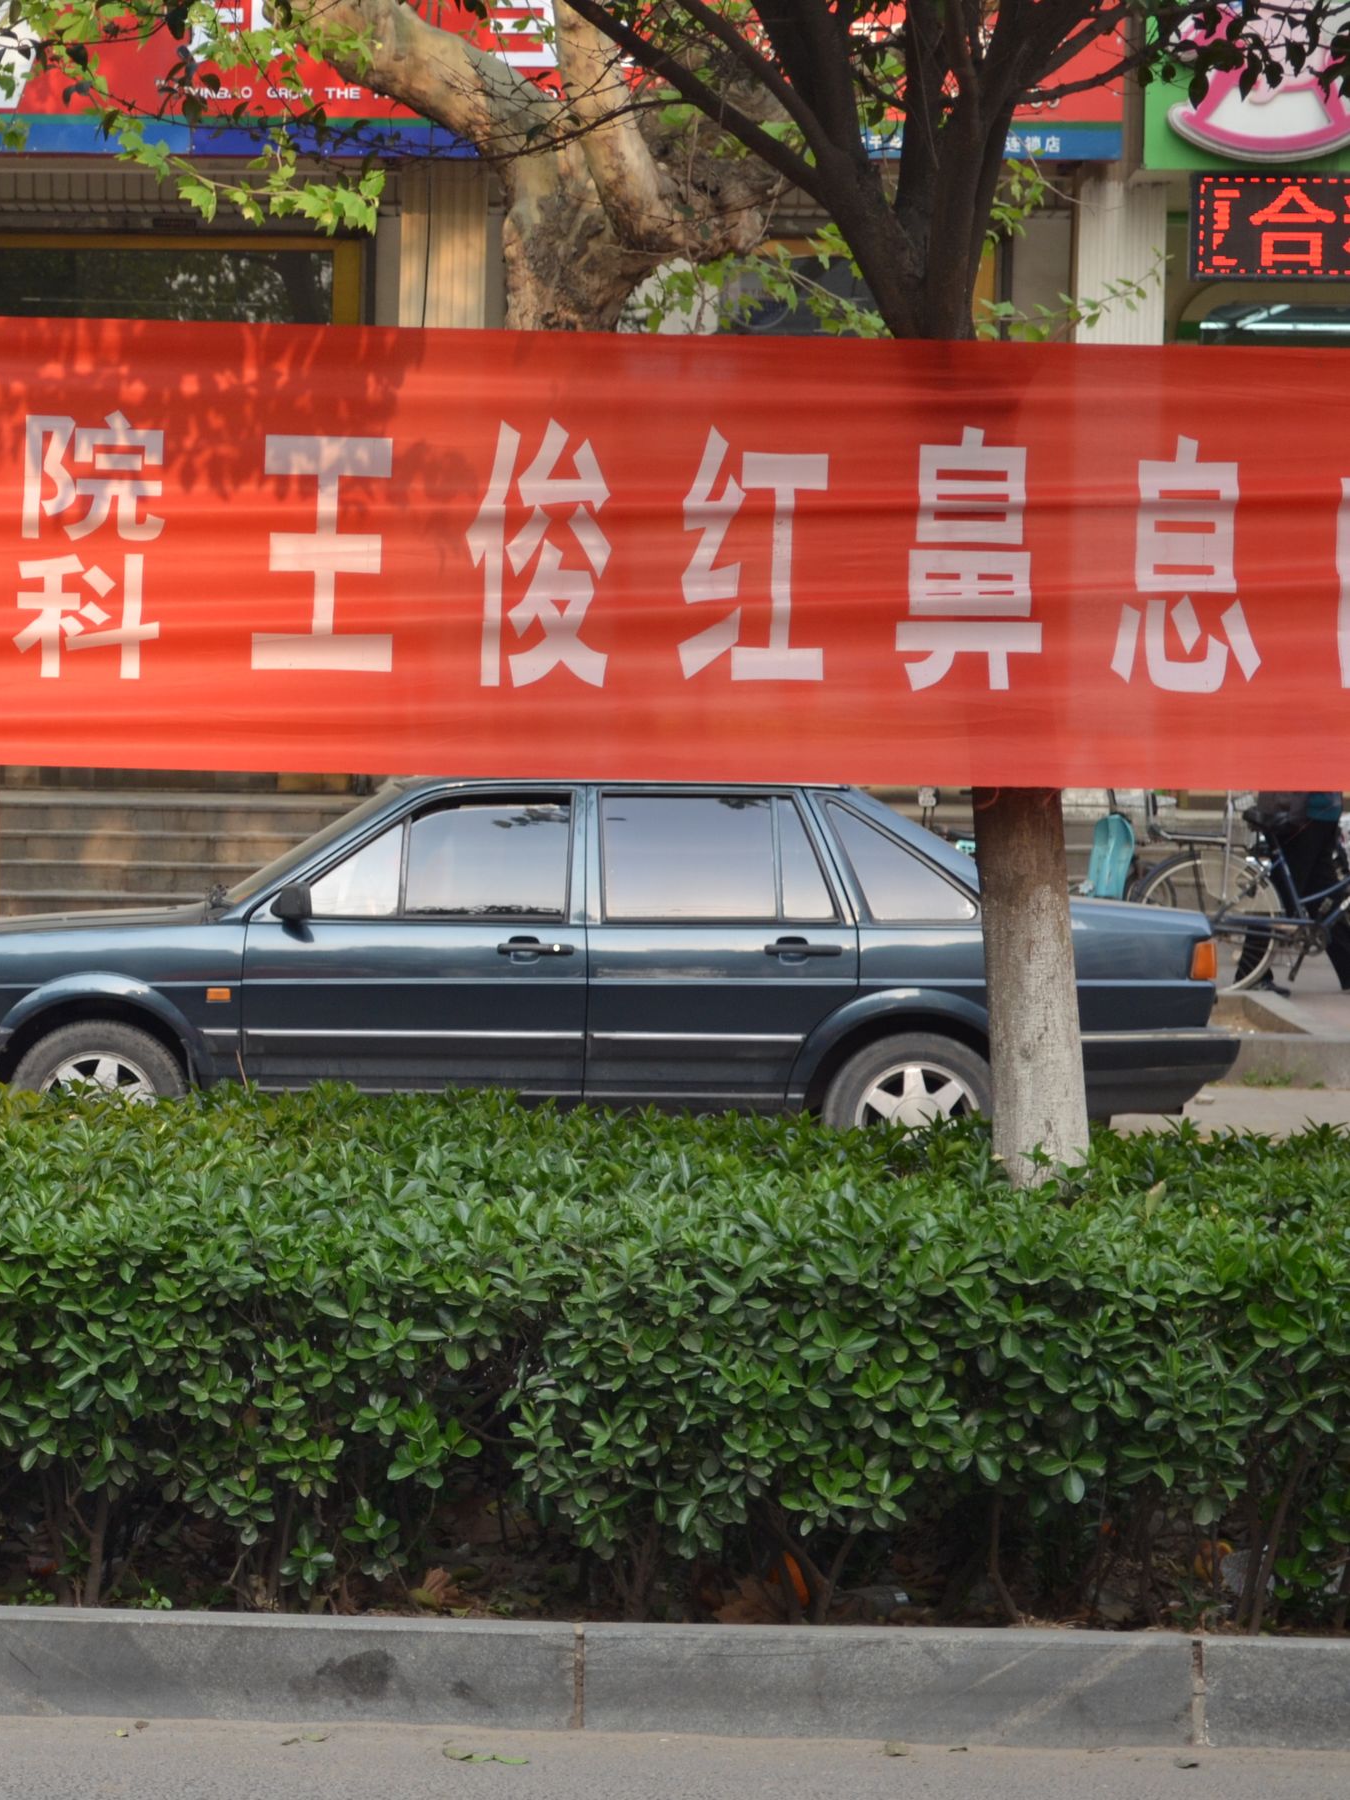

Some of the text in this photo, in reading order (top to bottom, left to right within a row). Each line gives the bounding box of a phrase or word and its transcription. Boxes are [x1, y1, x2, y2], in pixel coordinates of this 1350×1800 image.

[324, 87, 361, 100] THE
[1004, 135, 1061, 153] 连锁店
[250, 416, 1350, 694] 王俊红鼻息
